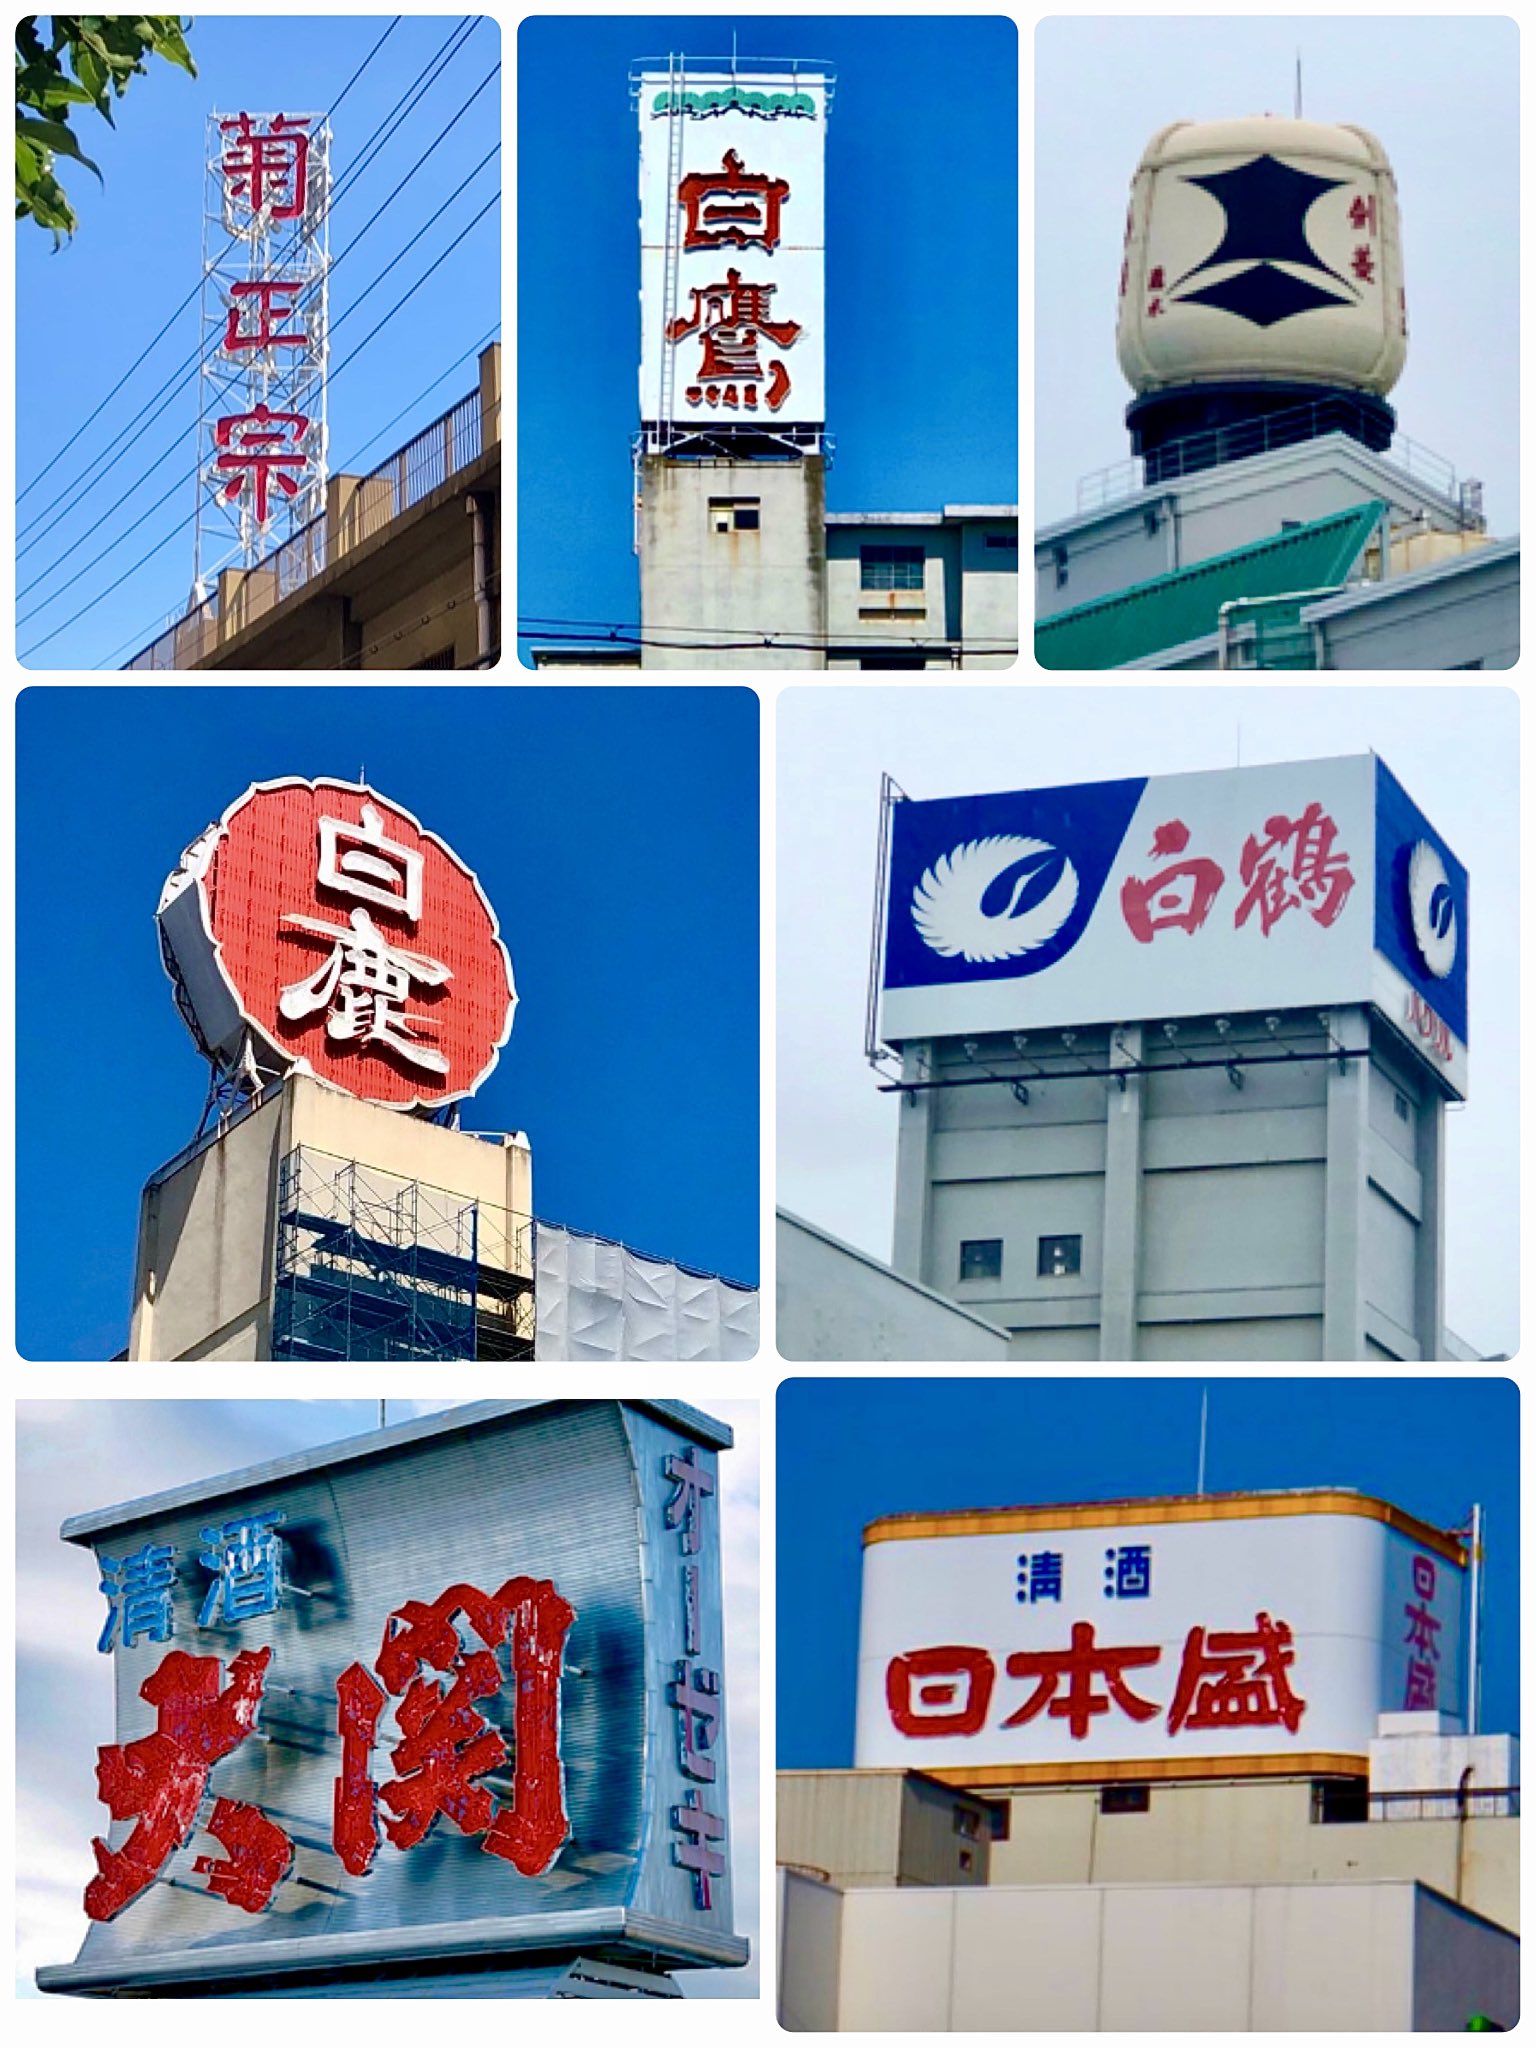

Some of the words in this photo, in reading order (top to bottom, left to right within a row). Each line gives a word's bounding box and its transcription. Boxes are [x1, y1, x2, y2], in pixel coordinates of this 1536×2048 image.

[218, 111, 311, 523] 菊正宗
[664, 147, 802, 412] 白鷹
[279, 803, 455, 1075] 白鹿
[1119, 801, 1356, 944] 白鶴
[663, 1445, 726, 1911] オーゼキ
[885, 1611, 1306, 1740] 日本盛
[1015, 1545, 1152, 1604] 清酒
